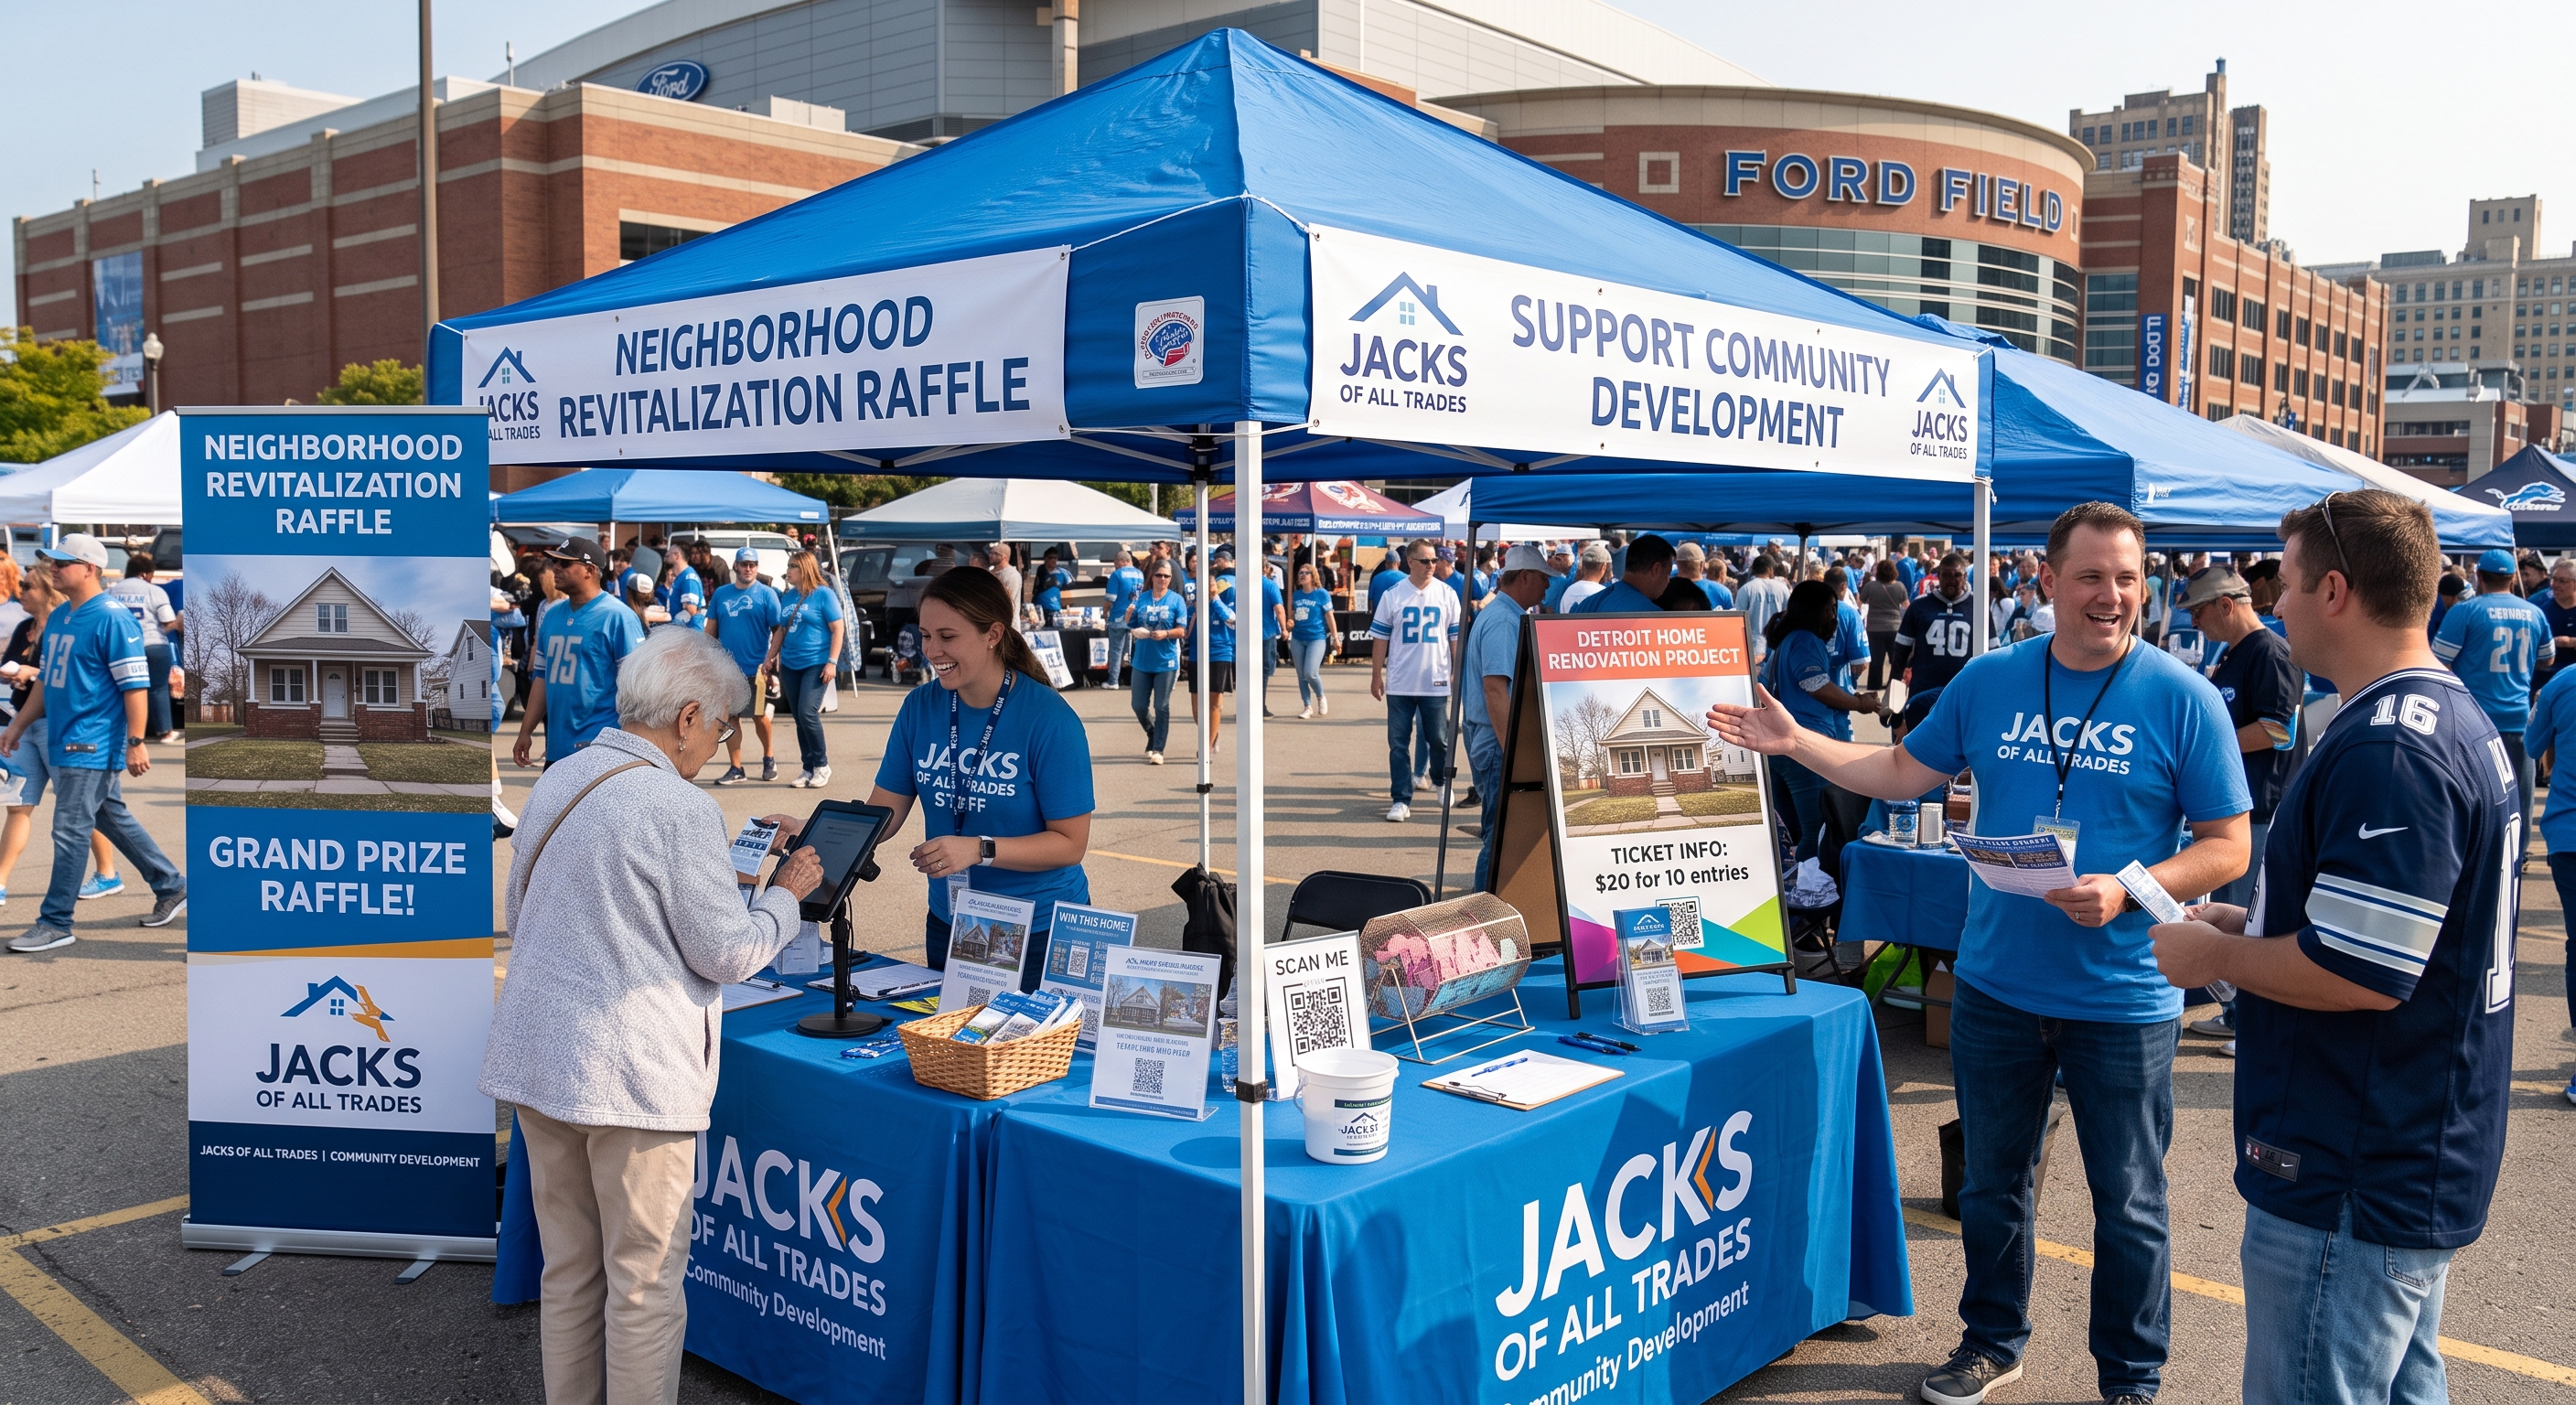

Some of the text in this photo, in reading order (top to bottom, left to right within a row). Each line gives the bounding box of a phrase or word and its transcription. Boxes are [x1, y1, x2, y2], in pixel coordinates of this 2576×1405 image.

[649, 69, 691, 98] Ford
[1724, 149, 2063, 233] FORD FIELD
[616, 295, 933, 376] NEIGHBORHOOD
[1510, 295, 1891, 397] SUPPORT COMMUNITY
[1340, 333, 1468, 388] JACKS
[559, 357, 1030, 439] REVITALIZATION RAFFLE
[1340, 384, 1467, 413] OF ALL TRADES
[1592, 376, 1844, 449] DEVELOPMENT
[488, 425, 541, 441] ALL TRADES
[1912, 410, 1968, 443] JACKS
[204, 434, 463, 461] NEIGHBORHOOD
[1910, 443, 1968, 460] OF ALL TRADES
[207, 471, 461, 499] REVITALIZATION
[276, 508, 392, 535] RAFFLE
[1402, 606, 1441, 644] 22
[1577, 627, 1706, 648] DETROIT HOME
[1926, 619, 1970, 658] 40
[548, 635, 583, 684] 75
[1548, 648, 1740, 670] RENOVATION PROJECT
[2489, 627, 2531, 673] 21
[2370, 693, 2441, 735] 16
[2001, 712, 2137, 756] JACKS
[918, 743, 1020, 780] JACKS
[1997, 745, 2131, 775] OF ALL TRADES
[917, 771, 1015, 797] OF AL RADES
[209, 835, 467, 874] GRAND PRIZE
[1611, 841, 1728, 865] TICKET INFO:
[261, 880, 415, 916] RAFFLE!
[1595, 865, 1749, 894] $20 for 10 entries
[1059, 911, 1078, 924] WIN
[1079, 915, 1098, 928] THIS
[1100, 917, 1129, 932] HOME!
[1275, 949, 1349, 976] SCAN ME
[255, 1043, 422, 1089] JACKS
[255, 1089, 423, 1114] OF ALL TRADES
[200, 1145, 480, 1168] JACKS OF ALL TRADES COMMUNITY DEVELOPMENT
[694, 1131, 886, 1264] JACKS
[1495, 1110, 1753, 1318] JACKS
[723, 1224, 767, 1271] ALL
[774, 1241, 886, 1316] TRADES
[685, 1254, 886, 1361] Community Development
[1495, 1217, 1752, 1381] OF ALL TRADES
[1627, 1281, 1749, 1372] Development
